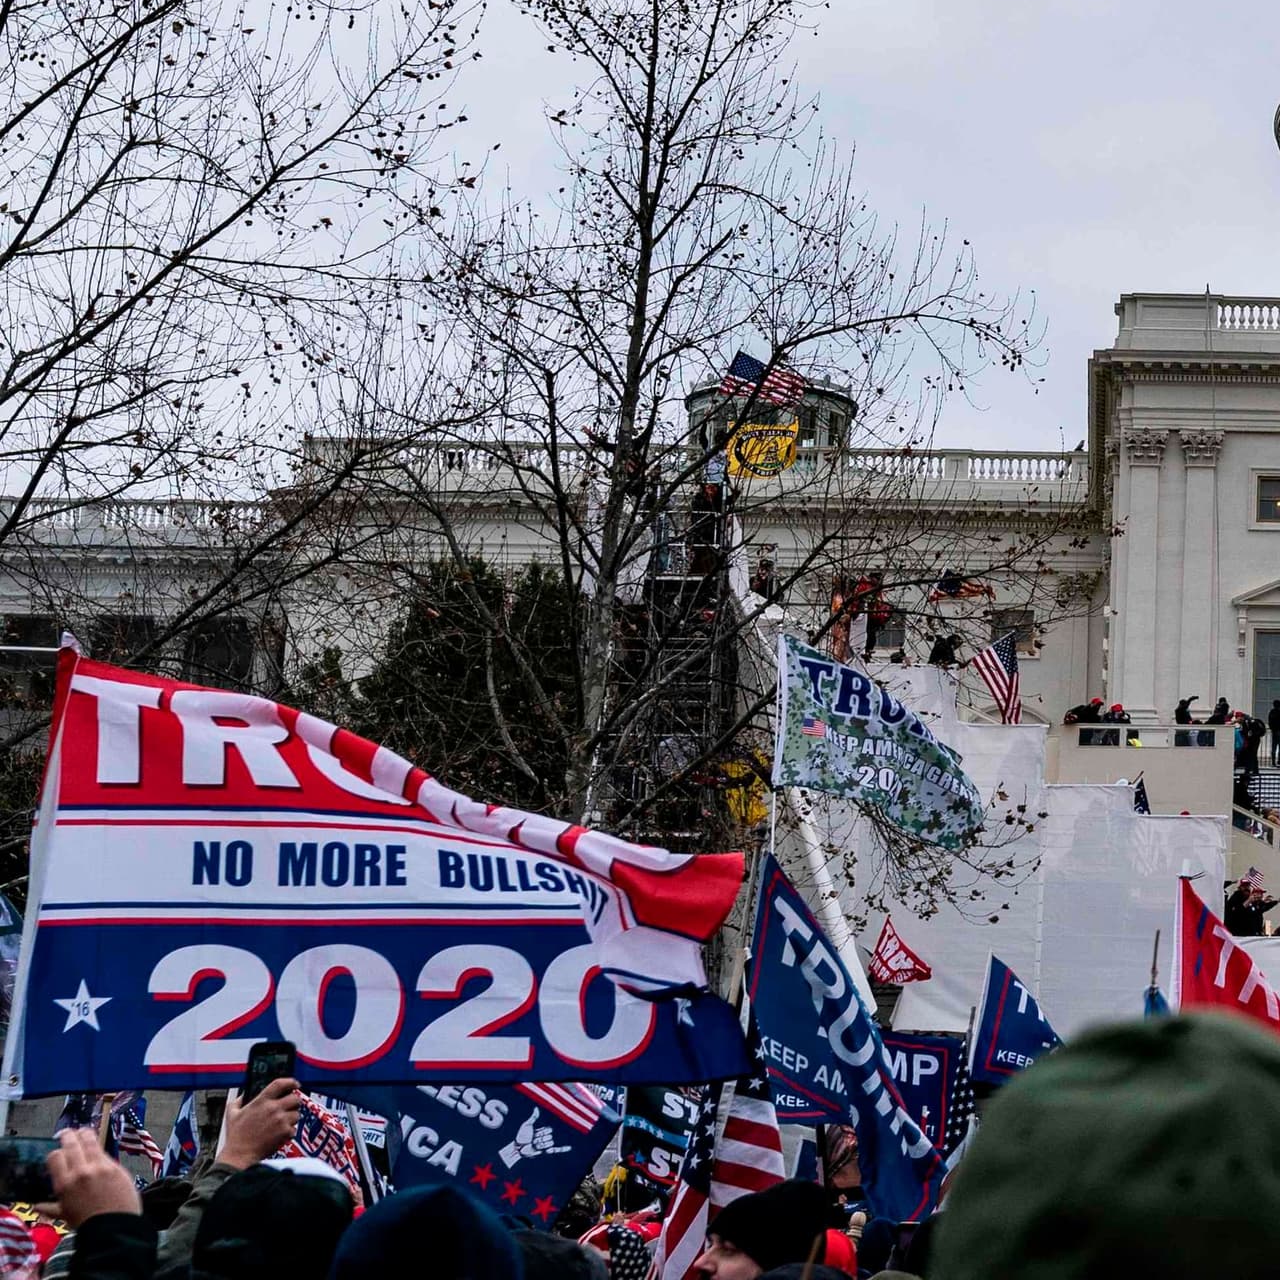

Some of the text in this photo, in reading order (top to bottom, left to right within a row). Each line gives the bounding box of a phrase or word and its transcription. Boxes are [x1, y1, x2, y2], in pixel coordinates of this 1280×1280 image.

[799, 656, 938, 745] TRU
[193, 841, 253, 886] NO
[278, 842, 407, 887] MORE
[143, 944, 656, 1073] 2020
[760, 1035, 810, 1074] KEEP
